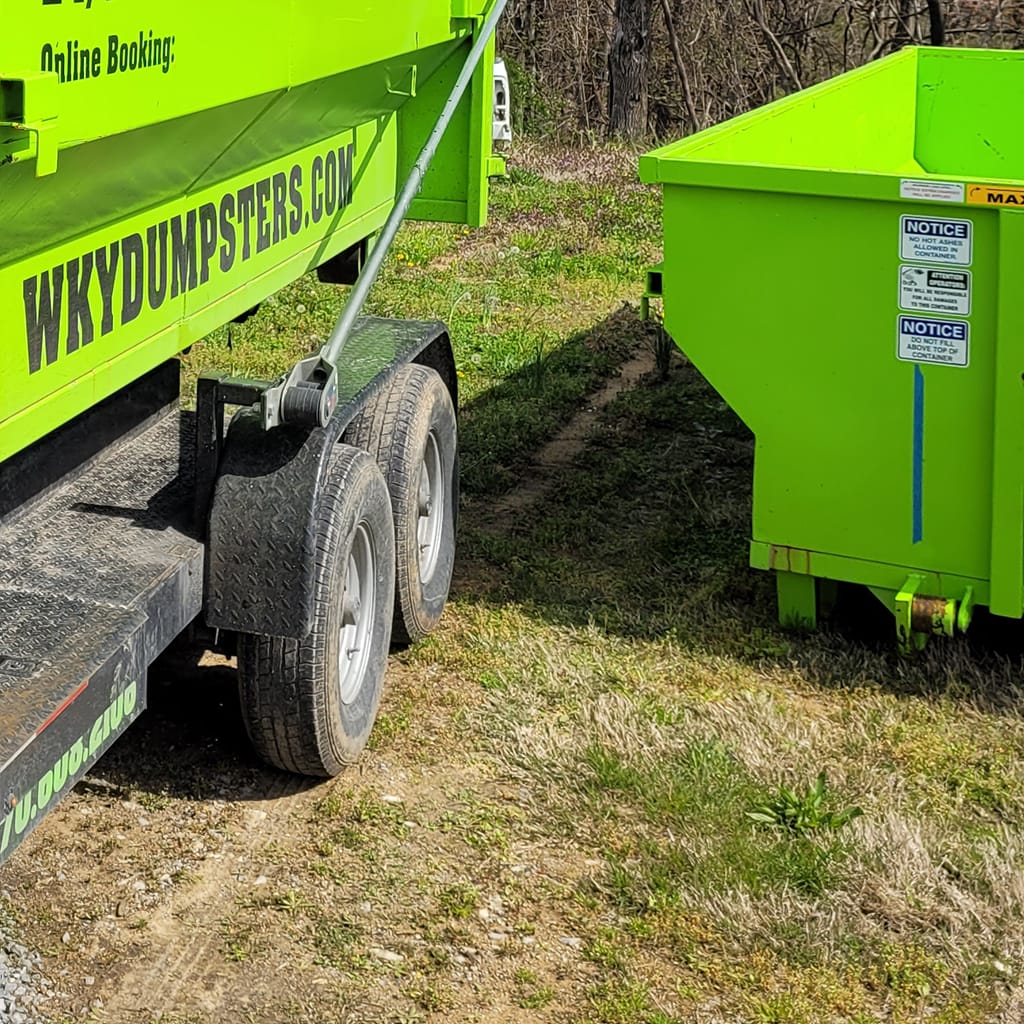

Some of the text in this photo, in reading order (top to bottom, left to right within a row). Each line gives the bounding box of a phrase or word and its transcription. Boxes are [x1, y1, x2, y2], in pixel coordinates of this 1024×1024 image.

[41, 30, 175, 84] Online Booking:
[906, 220, 965, 237] NOTICE
[913, 244, 949, 252] ALLOWED
[939, 239, 963, 247] ASHES
[23, 143, 354, 375] WKYDUMPSTERS.COM
[903, 320, 963, 338] NOTICE
[907, 343, 932, 352] ABOVE
[939, 339, 955, 347] FILL
[911, 351, 953, 362] CONTAINER
